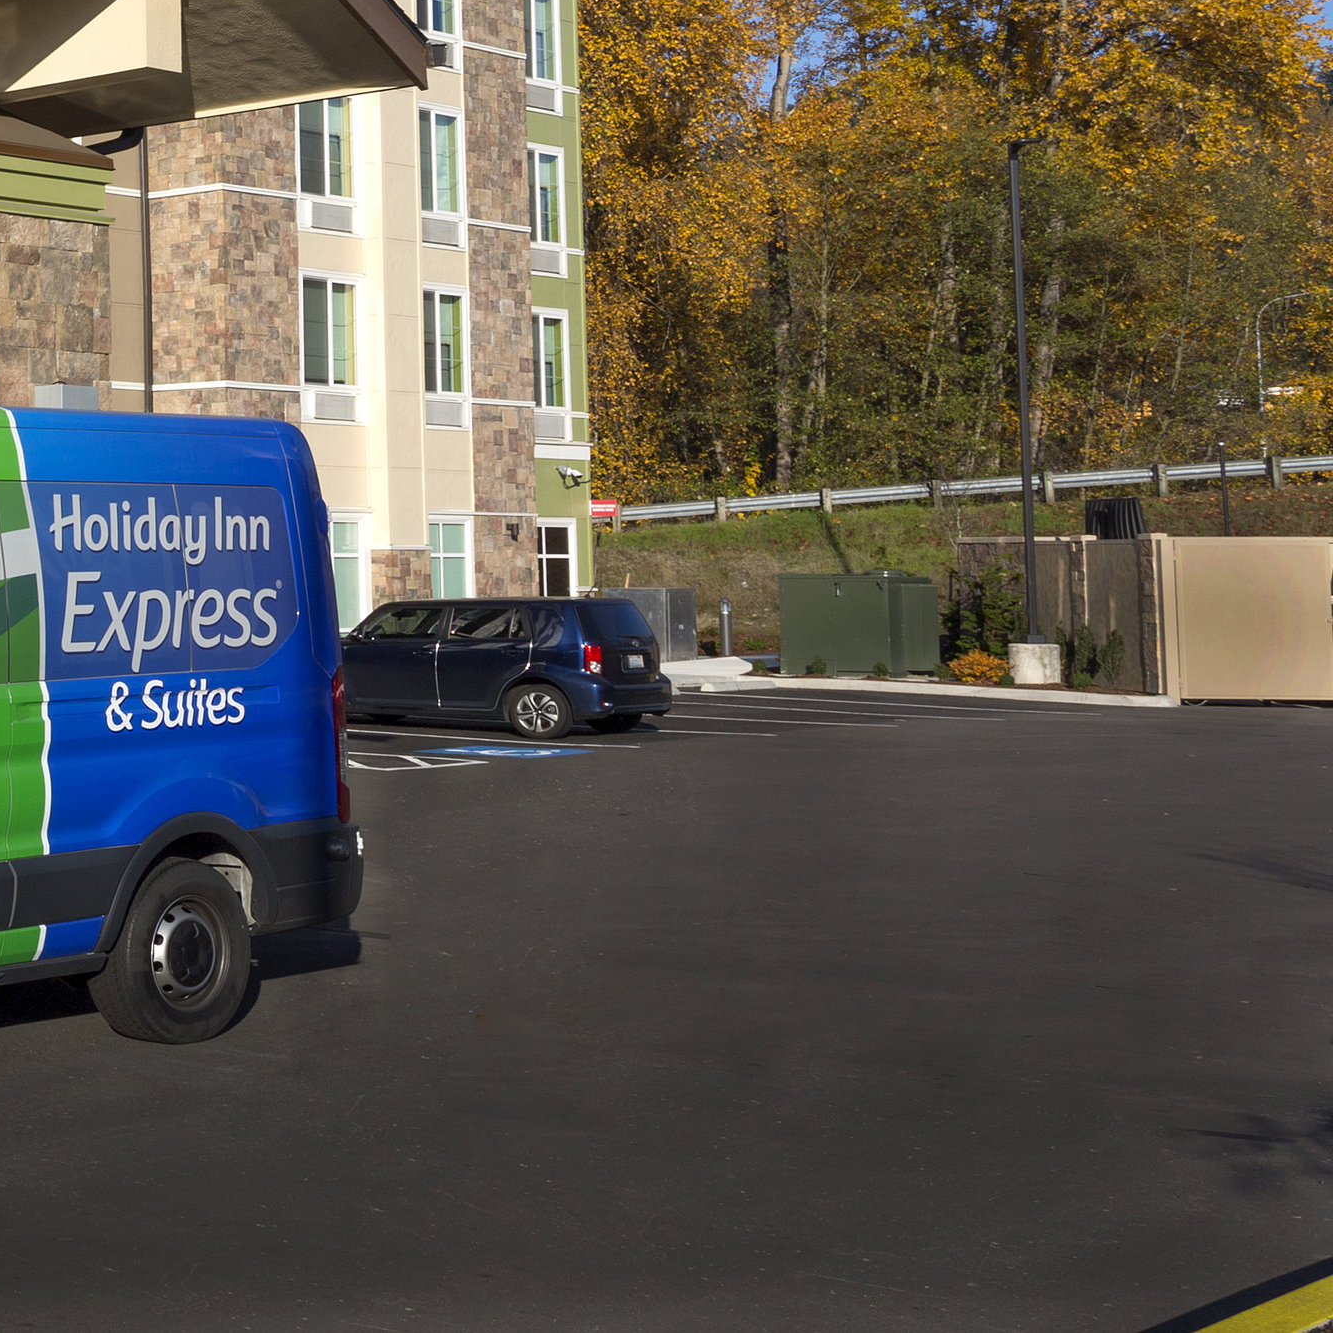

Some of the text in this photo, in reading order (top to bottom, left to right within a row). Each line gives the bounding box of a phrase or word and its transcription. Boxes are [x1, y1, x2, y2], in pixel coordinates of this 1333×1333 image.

[49, 494, 270, 565] Holiday Inn
[61, 571, 278, 673] Express
[105, 678, 246, 732] & Suites
